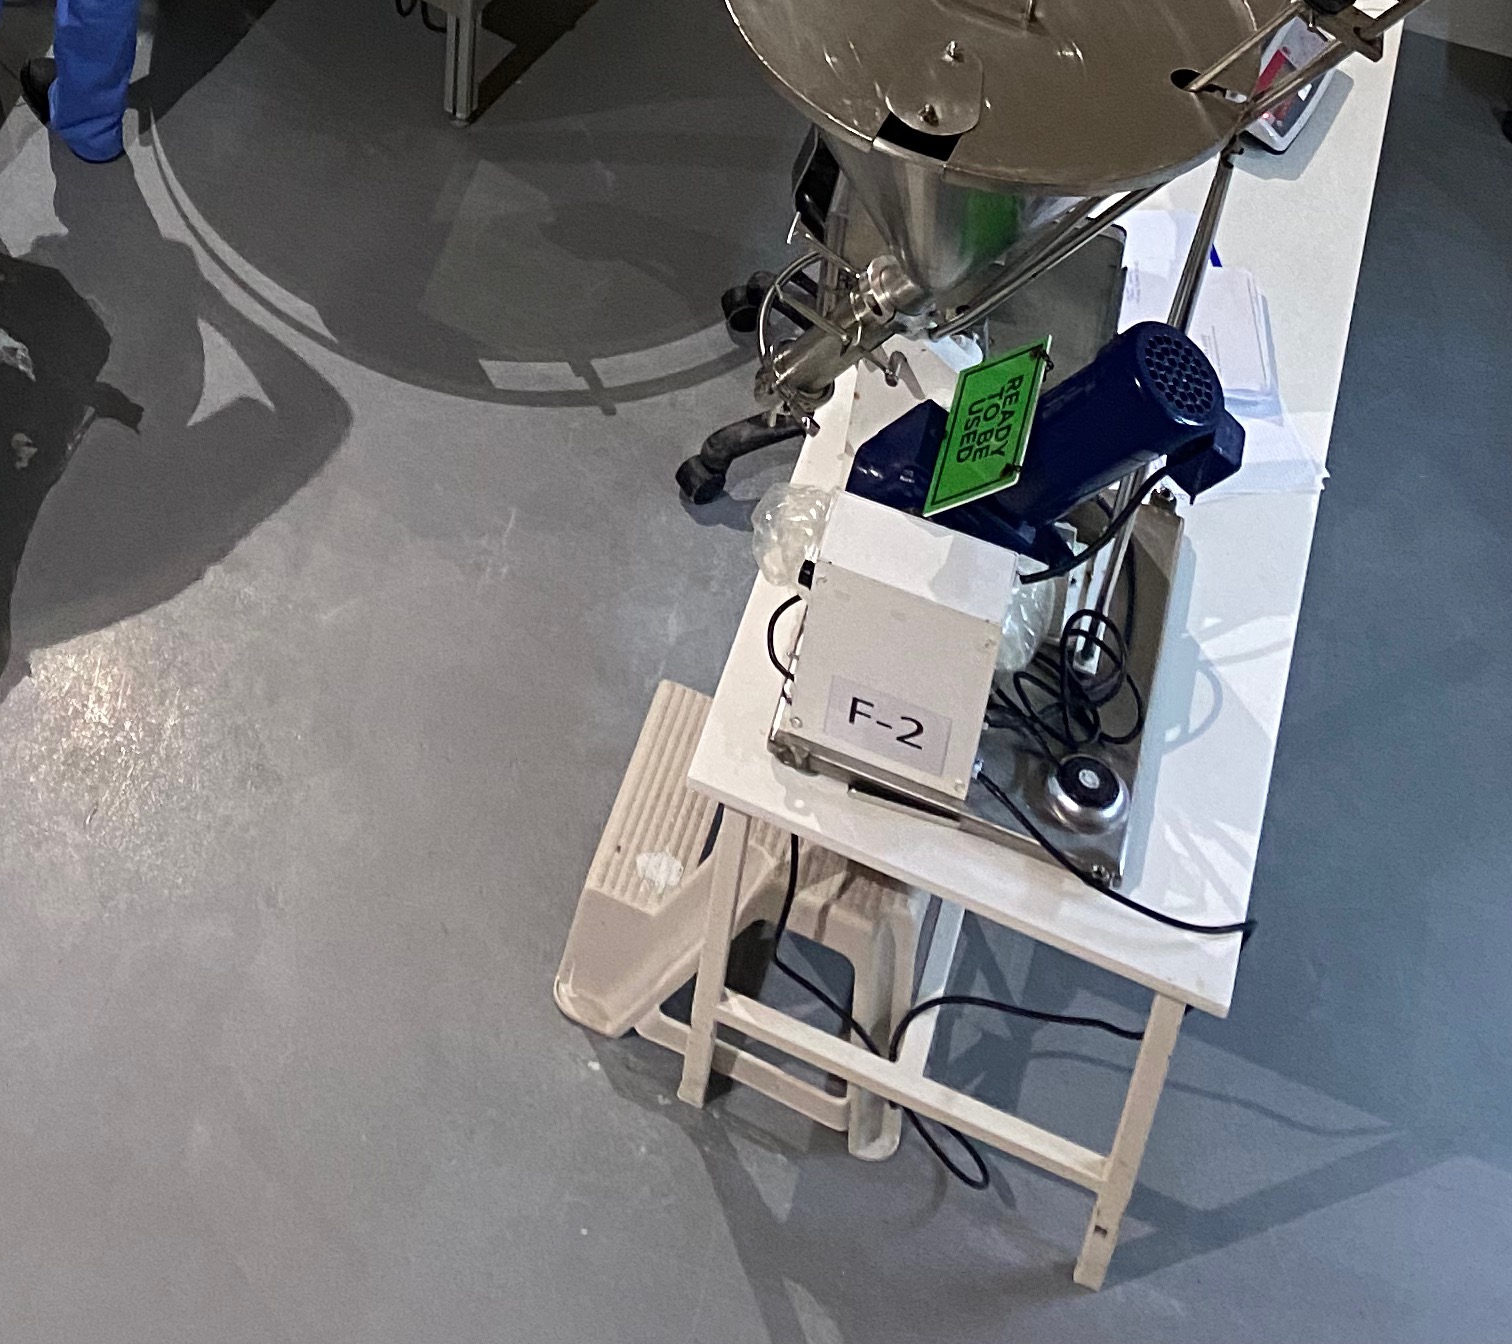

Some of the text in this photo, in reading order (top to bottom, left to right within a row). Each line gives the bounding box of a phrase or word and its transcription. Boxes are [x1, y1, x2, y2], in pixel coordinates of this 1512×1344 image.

[956, 398, 986, 464] USED
[972, 384, 1005, 462] TO BE
[990, 375, 1024, 457] READY
[849, 696, 924, 751] F-2
